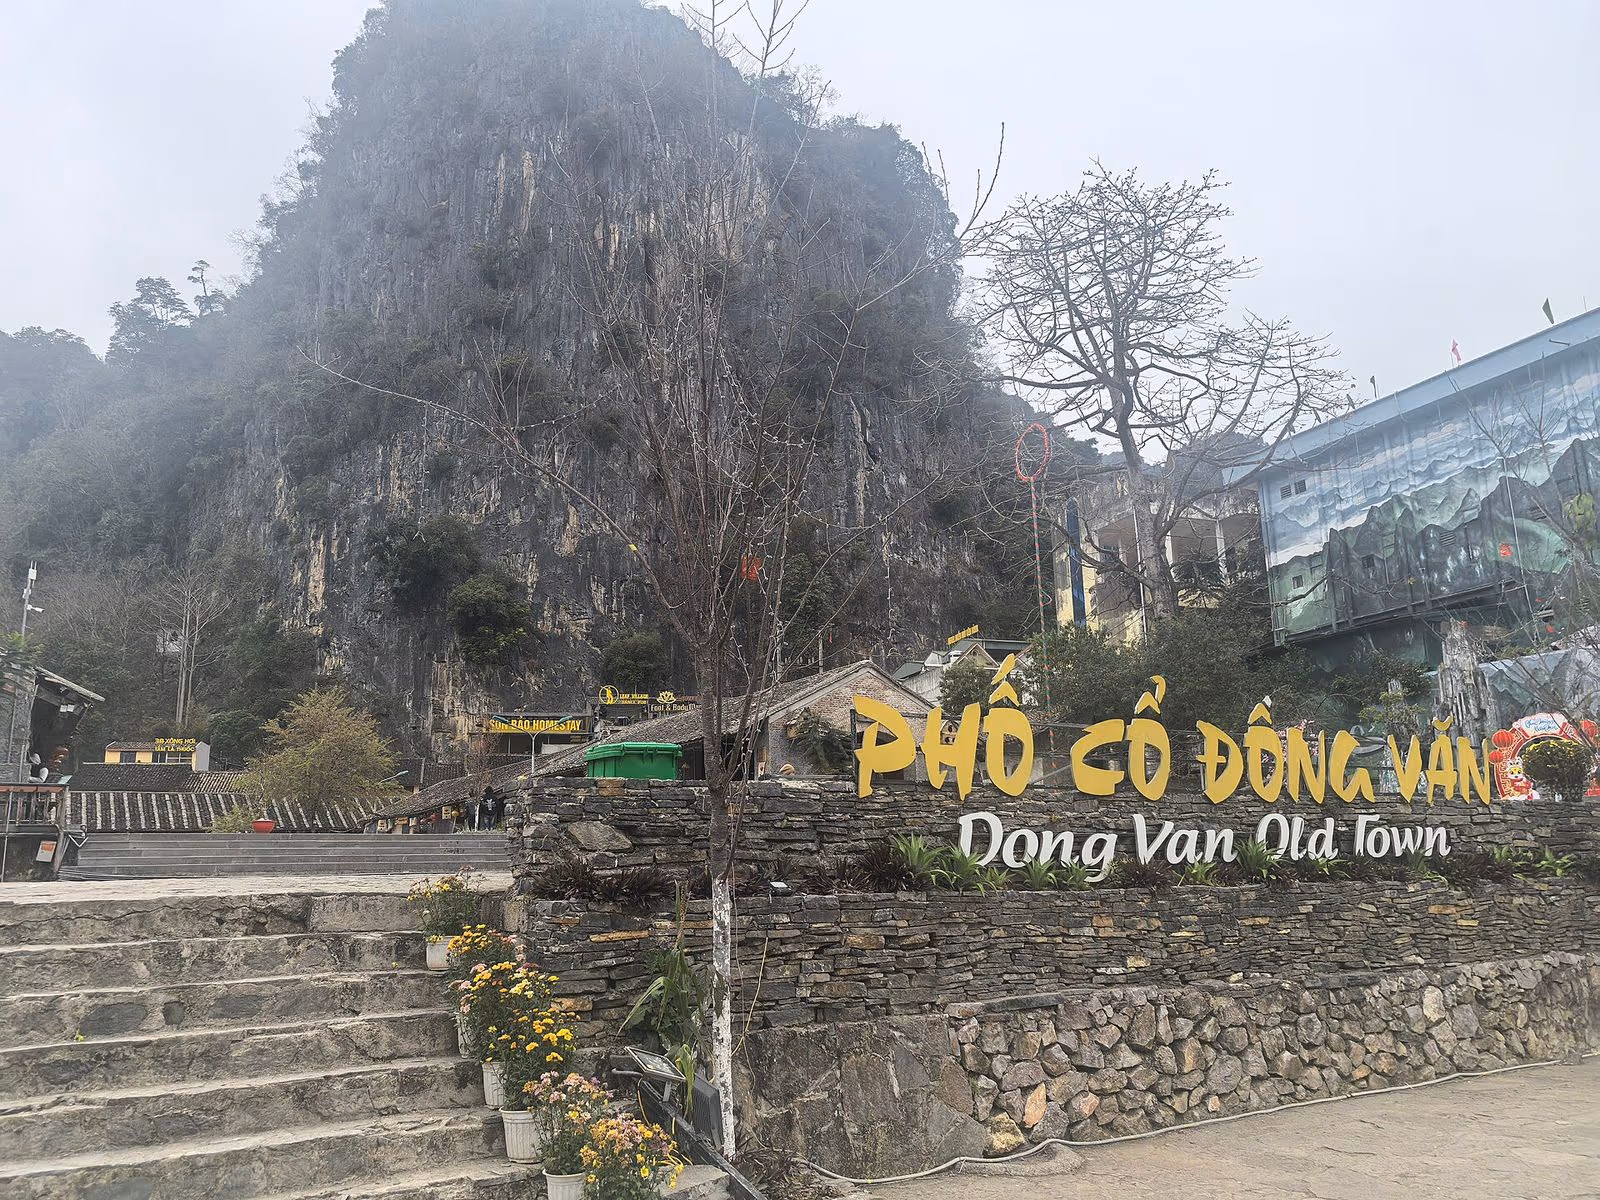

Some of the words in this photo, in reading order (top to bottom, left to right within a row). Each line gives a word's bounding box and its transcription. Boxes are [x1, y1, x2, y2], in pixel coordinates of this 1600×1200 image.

[532, 719, 583, 731] HOMESTAY
[852, 653, 1034, 801] PHỐ
[1070, 675, 1170, 801] CỔ
[1386, 715, 1491, 805] VĂN
[957, 811, 1118, 882] Dong
[1131, 813, 1238, 864] Van
[1255, 813, 1339, 861] Old
[1354, 814, 1451, 857] Town
